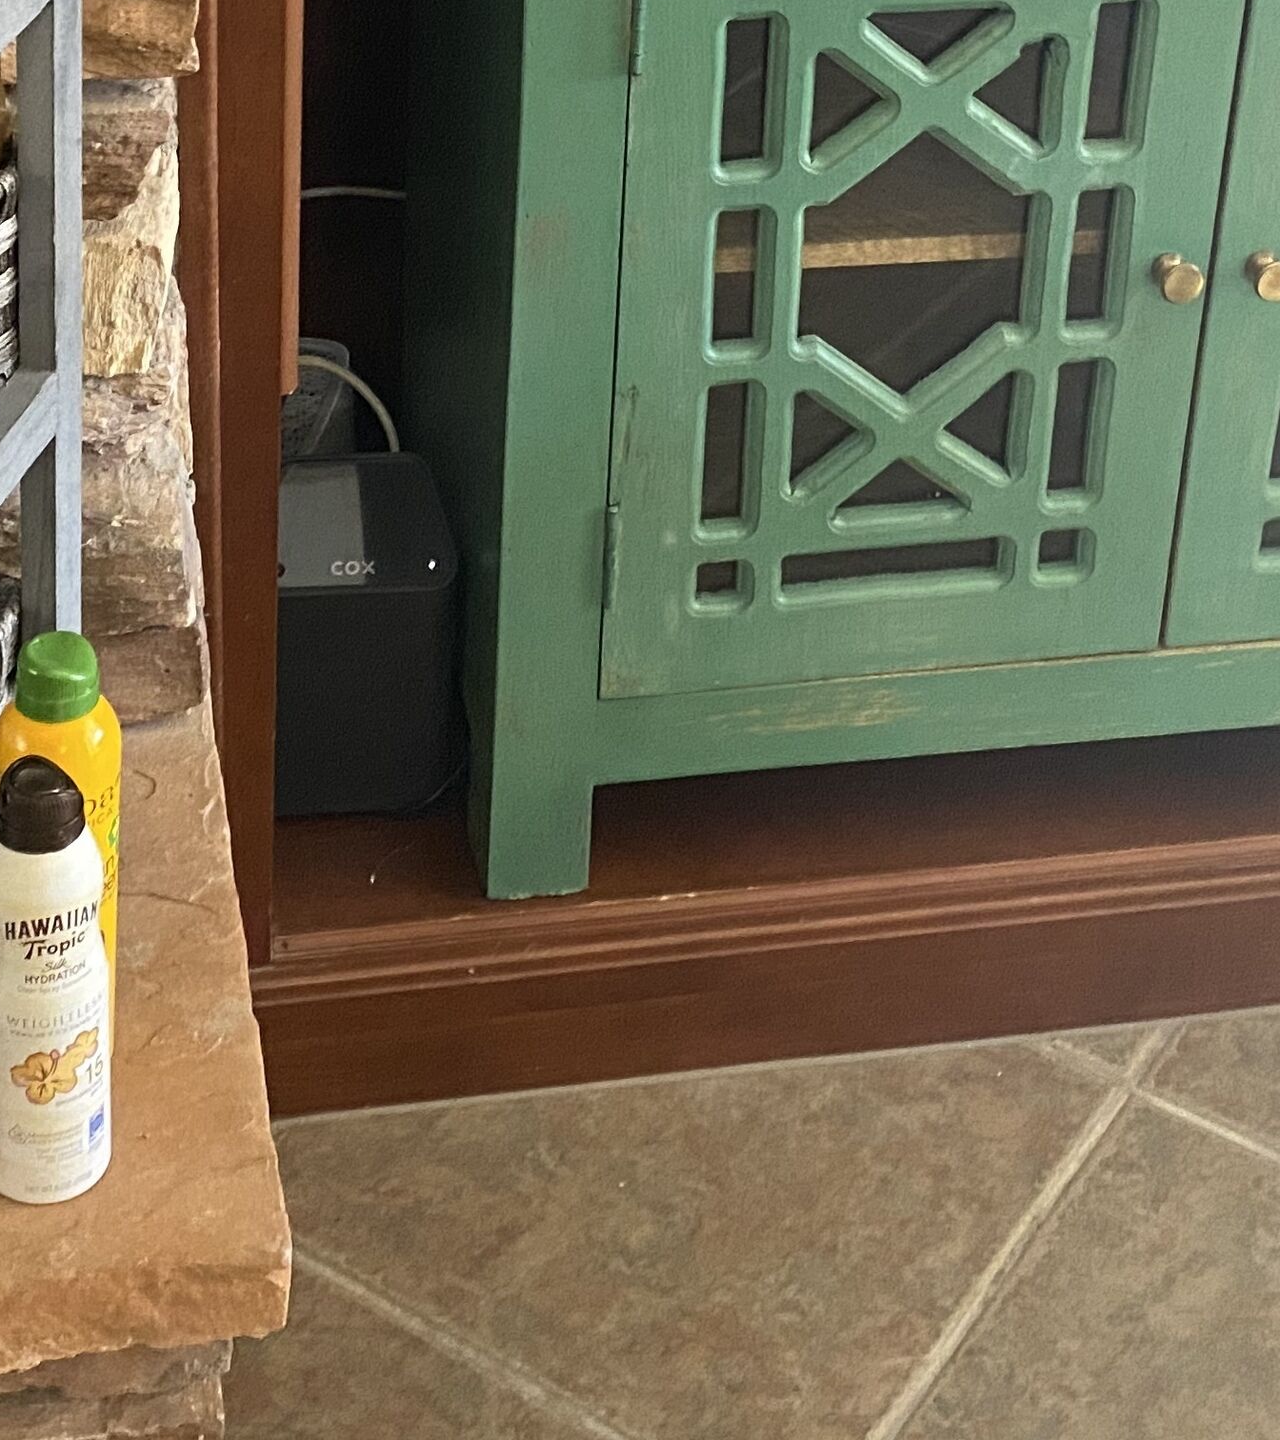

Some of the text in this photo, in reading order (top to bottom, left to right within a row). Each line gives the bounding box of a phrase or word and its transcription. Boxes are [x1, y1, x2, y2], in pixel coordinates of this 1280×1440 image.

[331, 561, 376, 575] COX
[4, 900, 98, 940] HAWAIIAN
[21, 931, 86, 960] Tropic
[24, 960, 87, 984] HYDRATION
